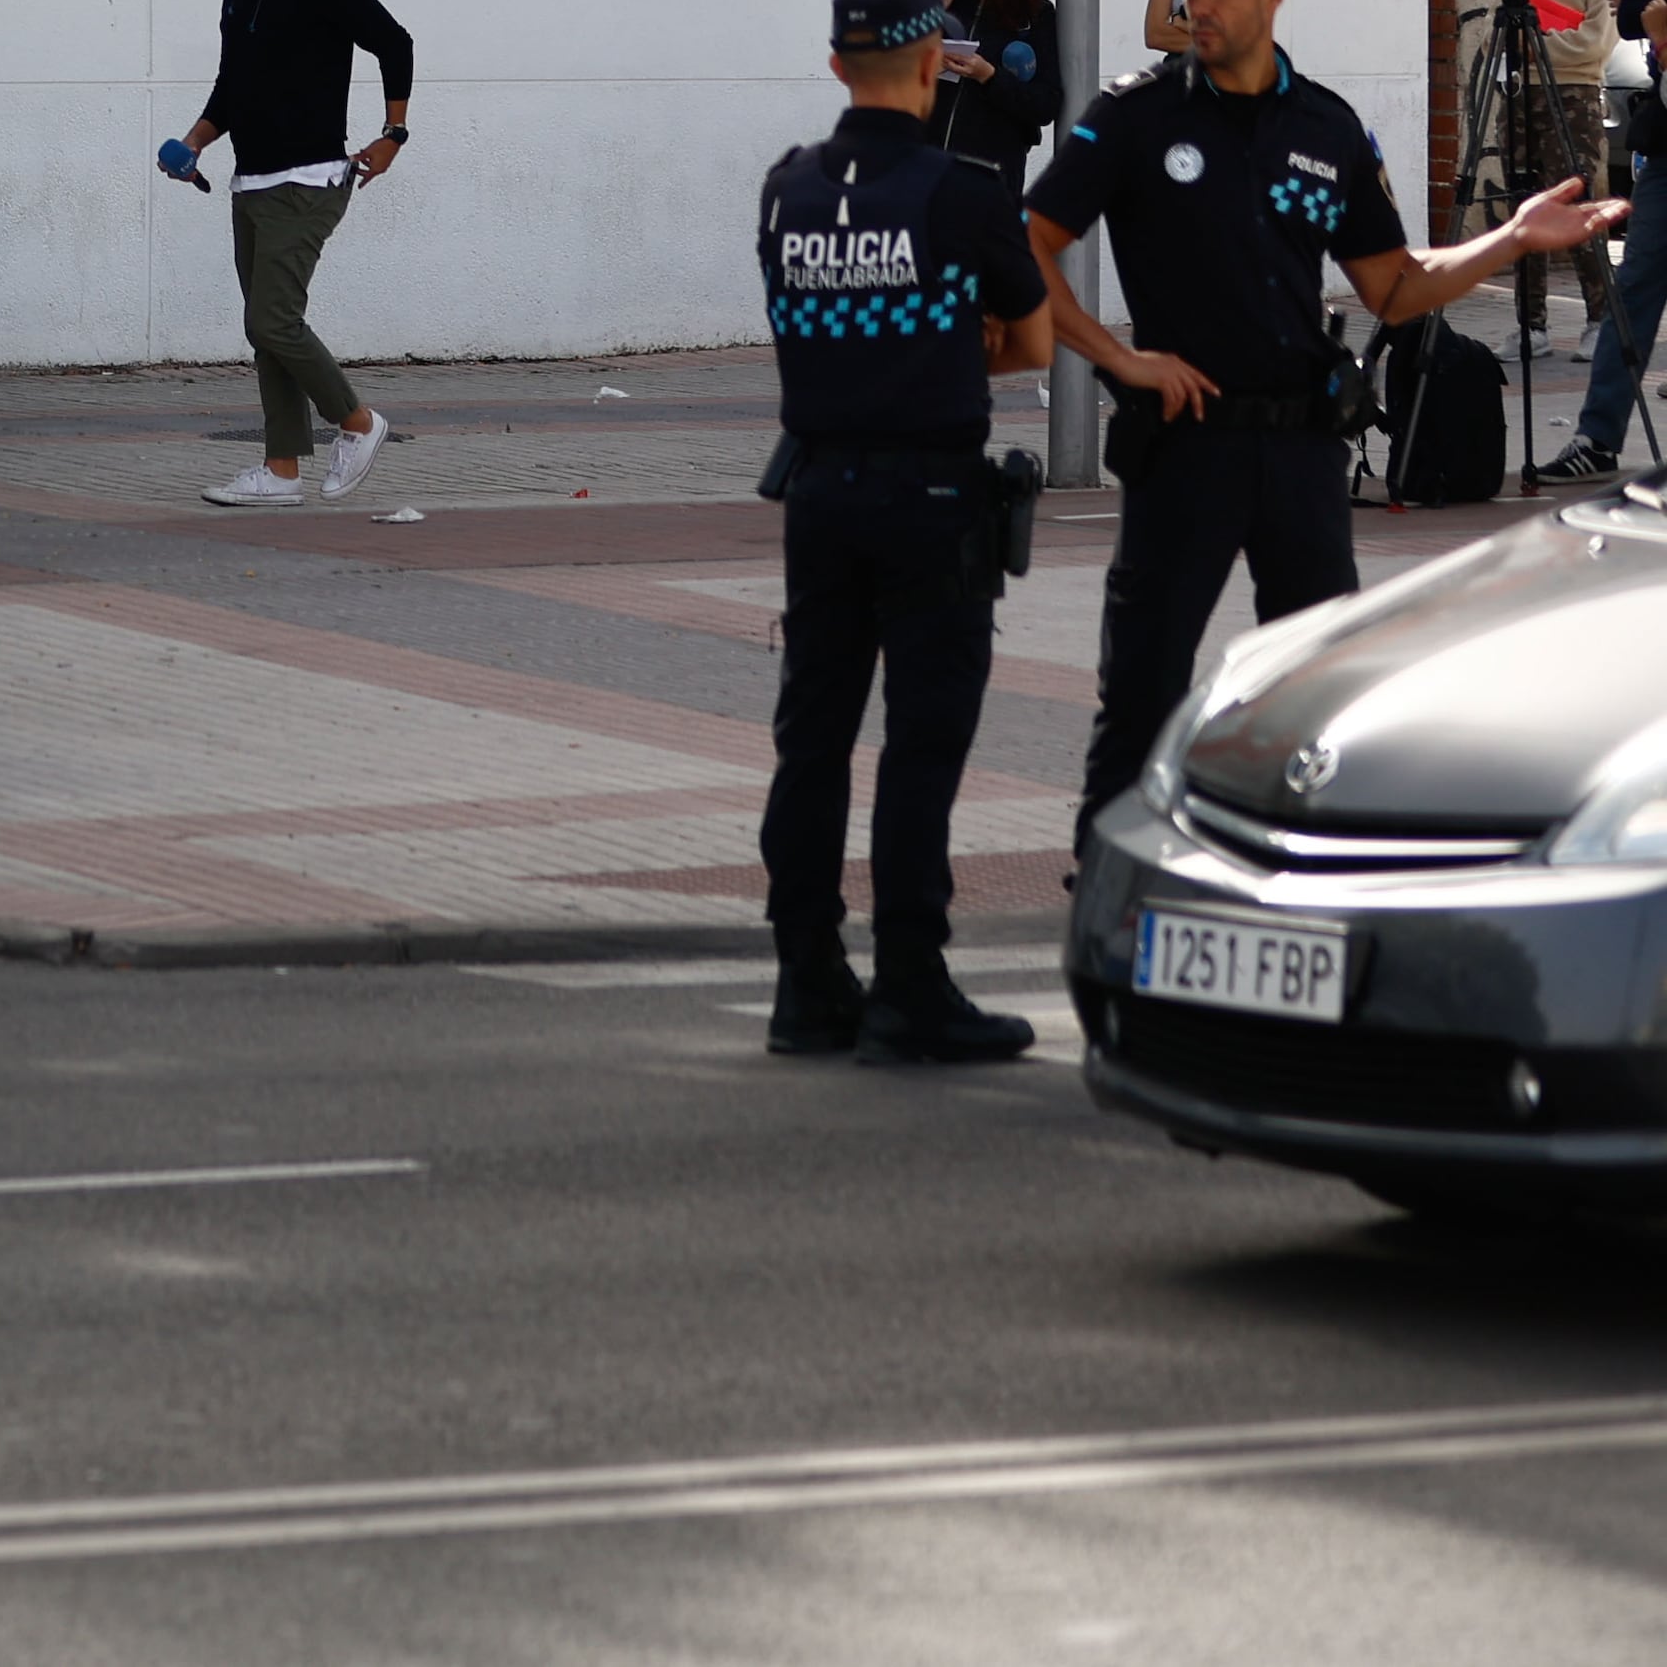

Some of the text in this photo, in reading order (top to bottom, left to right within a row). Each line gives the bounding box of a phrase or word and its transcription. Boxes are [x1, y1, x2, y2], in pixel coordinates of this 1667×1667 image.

[1287, 151, 1339, 183] POLICIA
[781, 229, 915, 268] POLICIA
[784, 264, 920, 290] FUENLABRADA
[1162, 923, 1335, 1008] 1251 FBP
